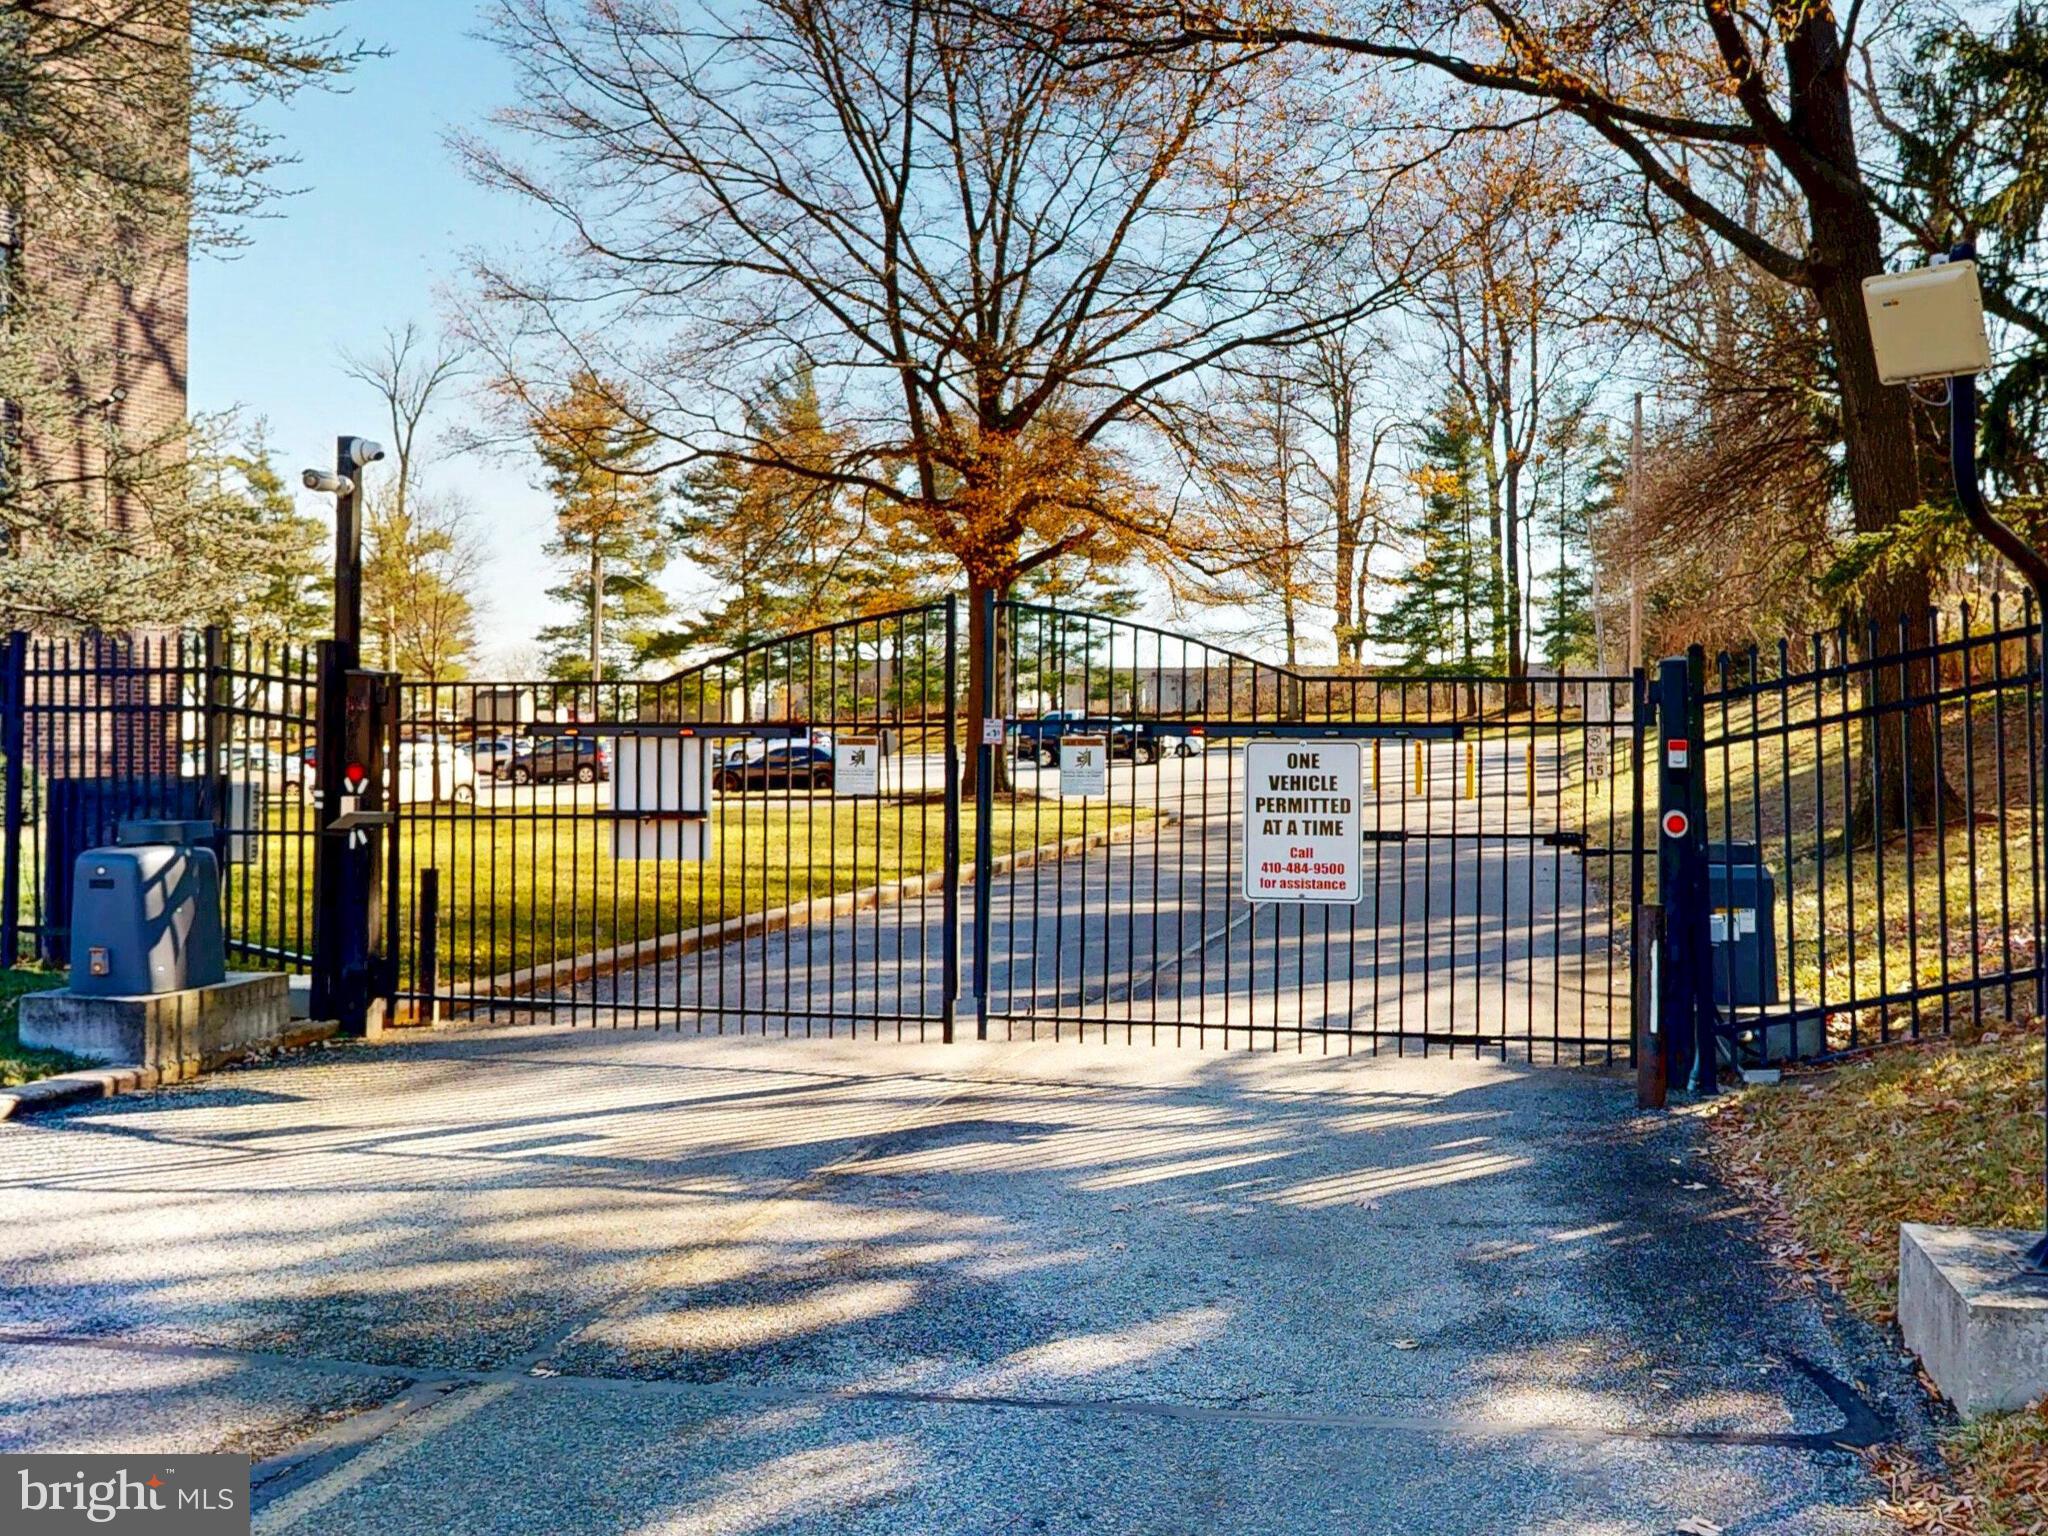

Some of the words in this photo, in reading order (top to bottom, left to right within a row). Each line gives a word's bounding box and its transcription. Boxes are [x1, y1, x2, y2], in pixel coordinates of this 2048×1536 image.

[1287, 753, 1320, 769] ONE
[1588, 765, 1604, 777] 15
[1268, 776, 1338, 791] VEHICLE
[1255, 797, 1351, 814] PERMITTED
[1262, 820, 1282, 835] AT
[1286, 820, 1298, 835] A
[1302, 820, 1344, 836] TIME
[1290, 847, 1314, 858] Call
[1261, 863, 1345, 875] 410-484-9500
[1260, 878, 1276, 889] for
[1279, 878, 1346, 890] assistance
